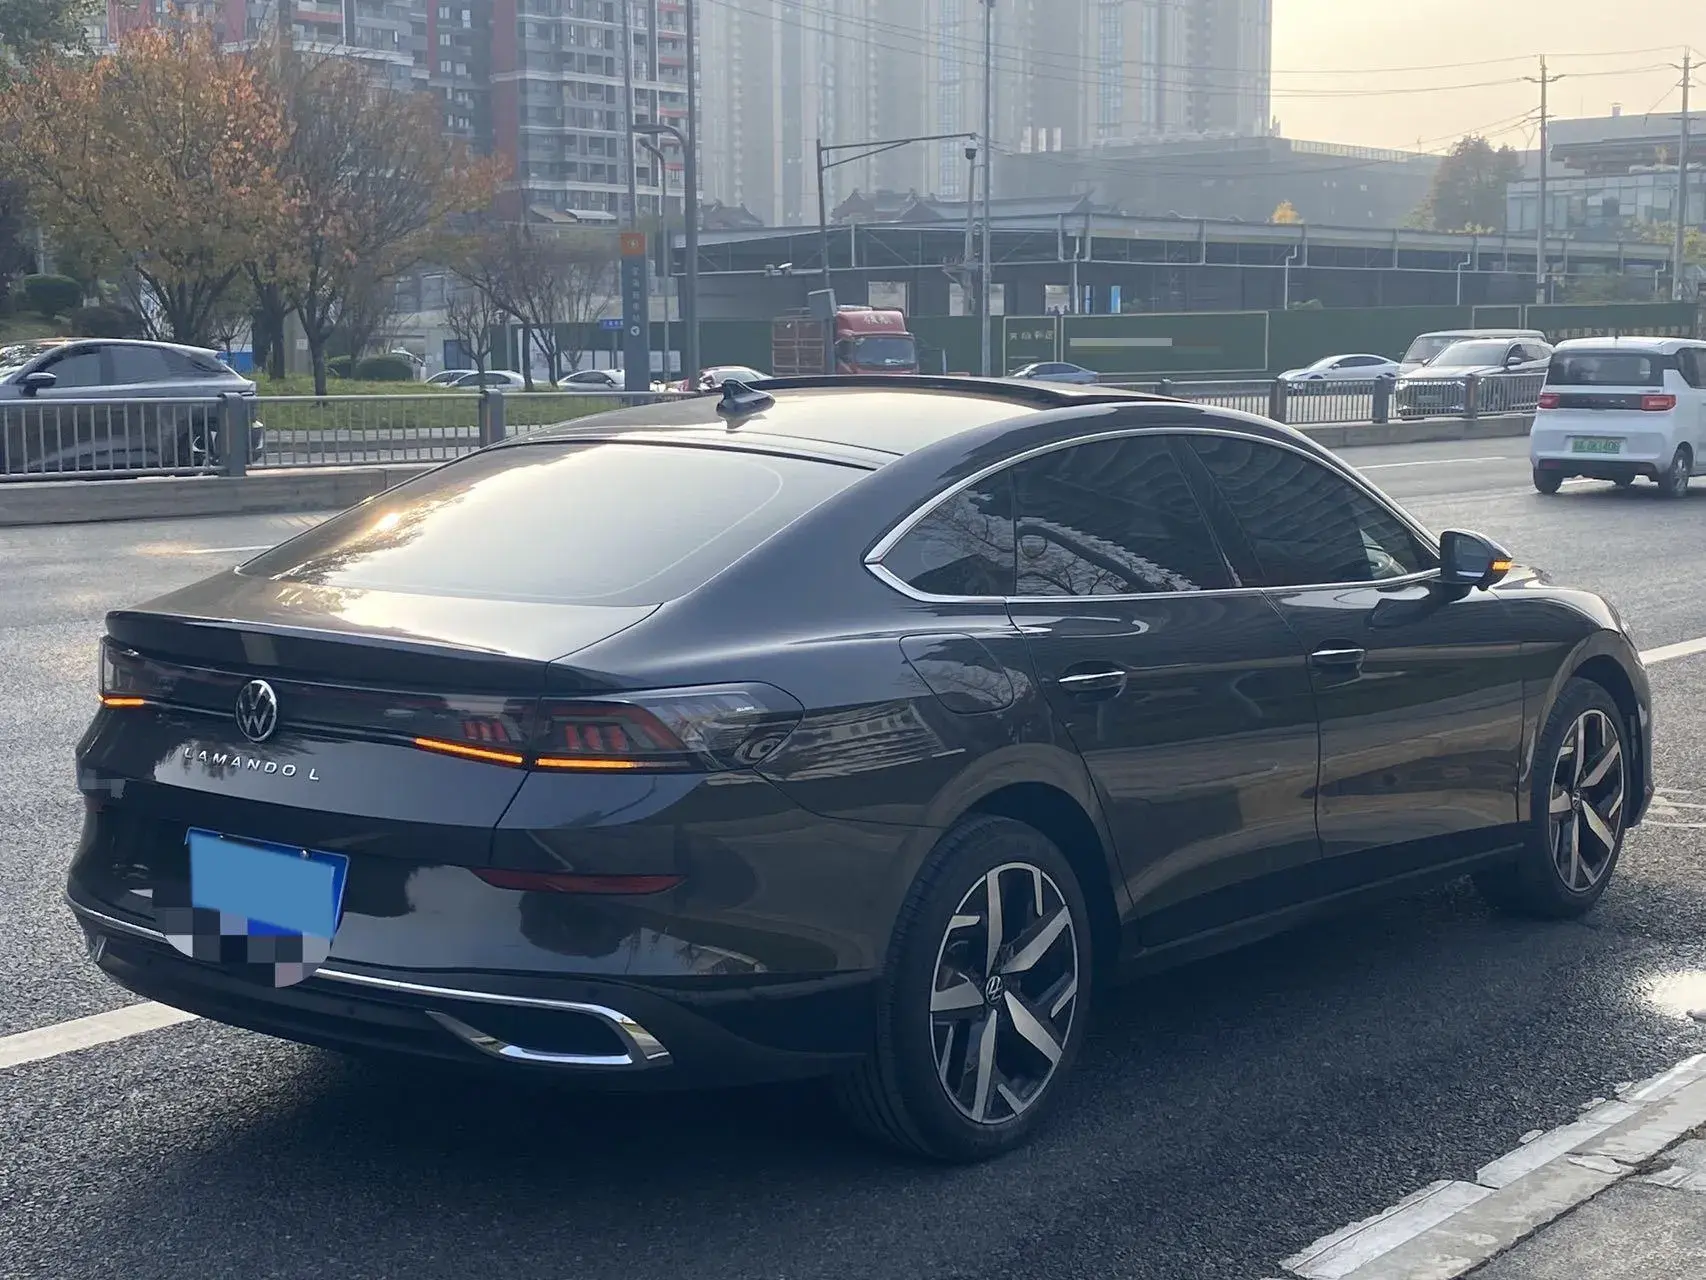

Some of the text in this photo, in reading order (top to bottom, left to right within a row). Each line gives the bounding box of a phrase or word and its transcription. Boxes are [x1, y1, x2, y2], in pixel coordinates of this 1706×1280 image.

[236, 680, 277, 742] VW
[184, 747, 320, 781] LAMANDO L
